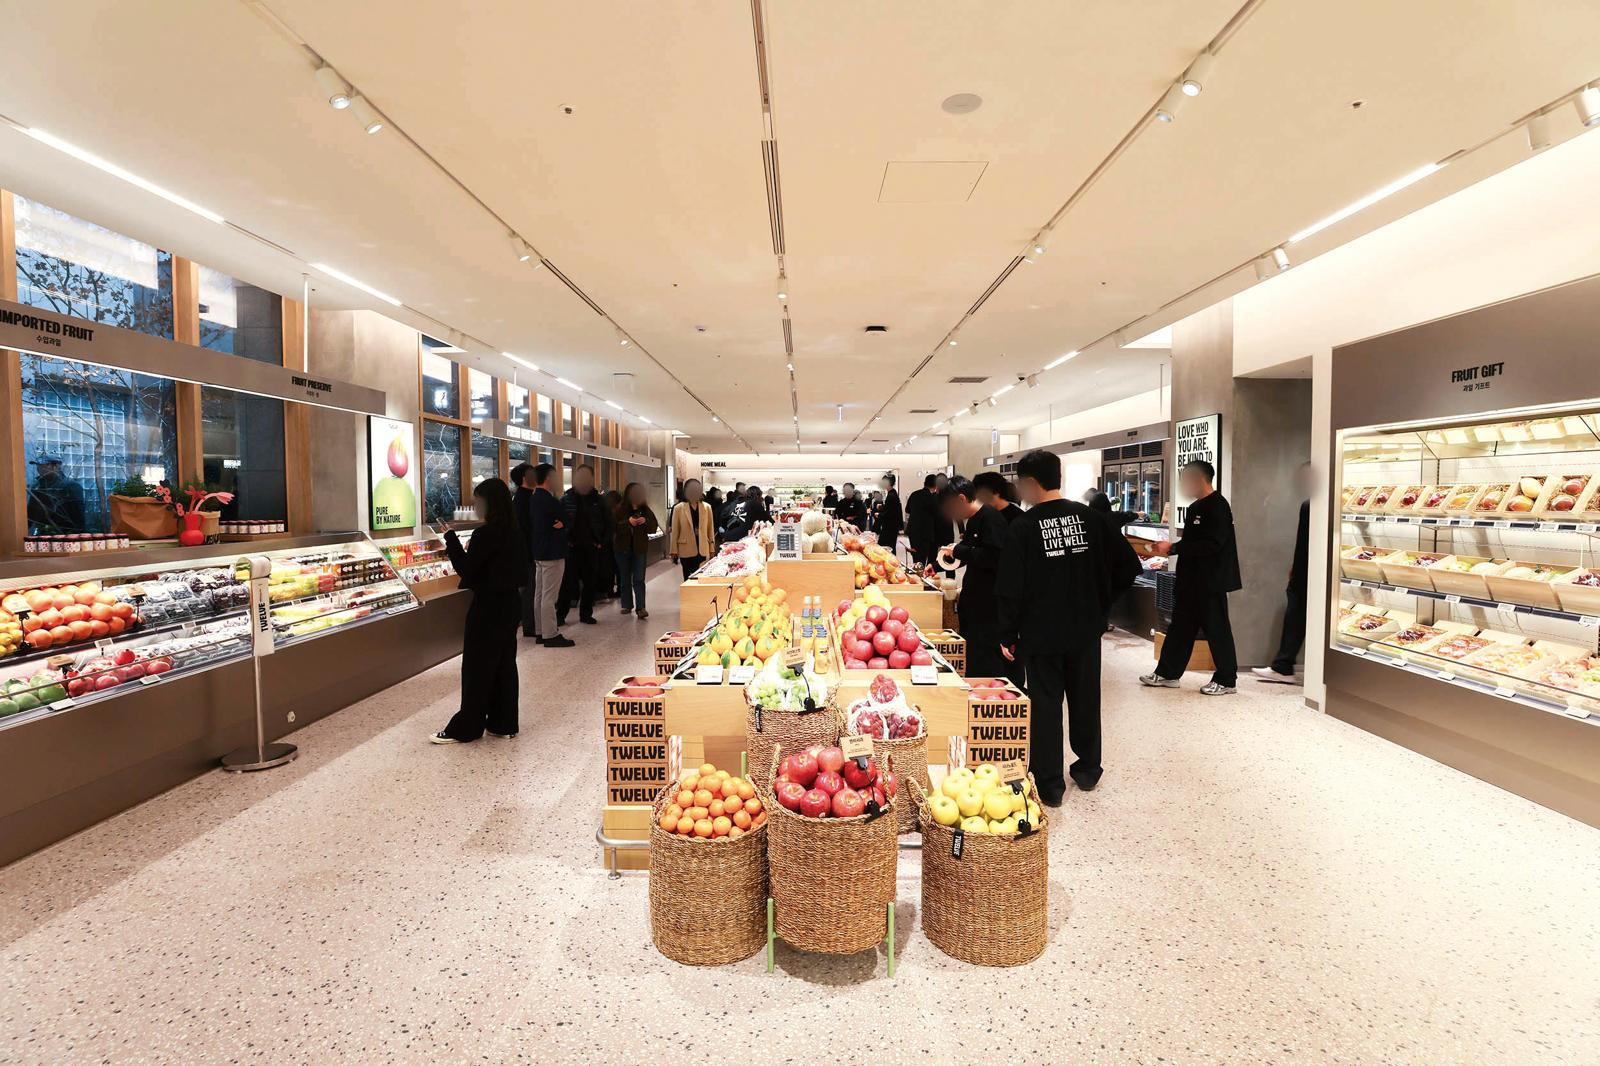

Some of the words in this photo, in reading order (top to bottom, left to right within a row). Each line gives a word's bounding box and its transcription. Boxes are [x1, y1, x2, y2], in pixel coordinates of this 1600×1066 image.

[62, 324, 94, 341] FRUIT
[1452, 366, 1479, 383] FRUIT
[1481, 362, 1504, 378] GIFT
[292, 376, 307, 387] FRUIT
[308, 379, 332, 392] PRESERVE
[1463, 384, 1473, 392] 과일
[1475, 382, 1490, 391] 기프트
[1178, 424, 1194, 439] LOVE
[1196, 421, 1208, 434] WHO
[1178, 440, 1191, 453] YOU
[1193, 437, 1208, 451] ARE.
[1178, 454, 1186, 467] BE
[1205, 451, 1212, 462] TO
[376, 506, 388, 515] PURE
[376, 516, 382, 524] BY
[384, 515, 400, 523] NATURE
[1039, 518, 1059, 529] LOVE
[1059, 515, 1084, 526] WELL.
[1042, 528, 1062, 539] GIVE
[1062, 525, 1086, 536] WELL.
[1044, 538, 1063, 550] LIVE
[1064, 535, 1088, 547] WELL.
[258, 602, 268, 632] TWELVE
[657, 647, 691, 658] TWEL
[935, 643, 964, 654] ELVE
[607, 702, 662, 716] TWELVE
[972, 705, 1027, 718] TWELVE
[608, 724, 663, 737] TWELVE
[971, 727, 1026, 740] TWELVE
[610, 746, 665, 760] TWELVE
[970, 748, 1025, 761] TWELVE
[610, 767, 665, 781] TWELVE
[611, 789, 661, 802] TWELV
